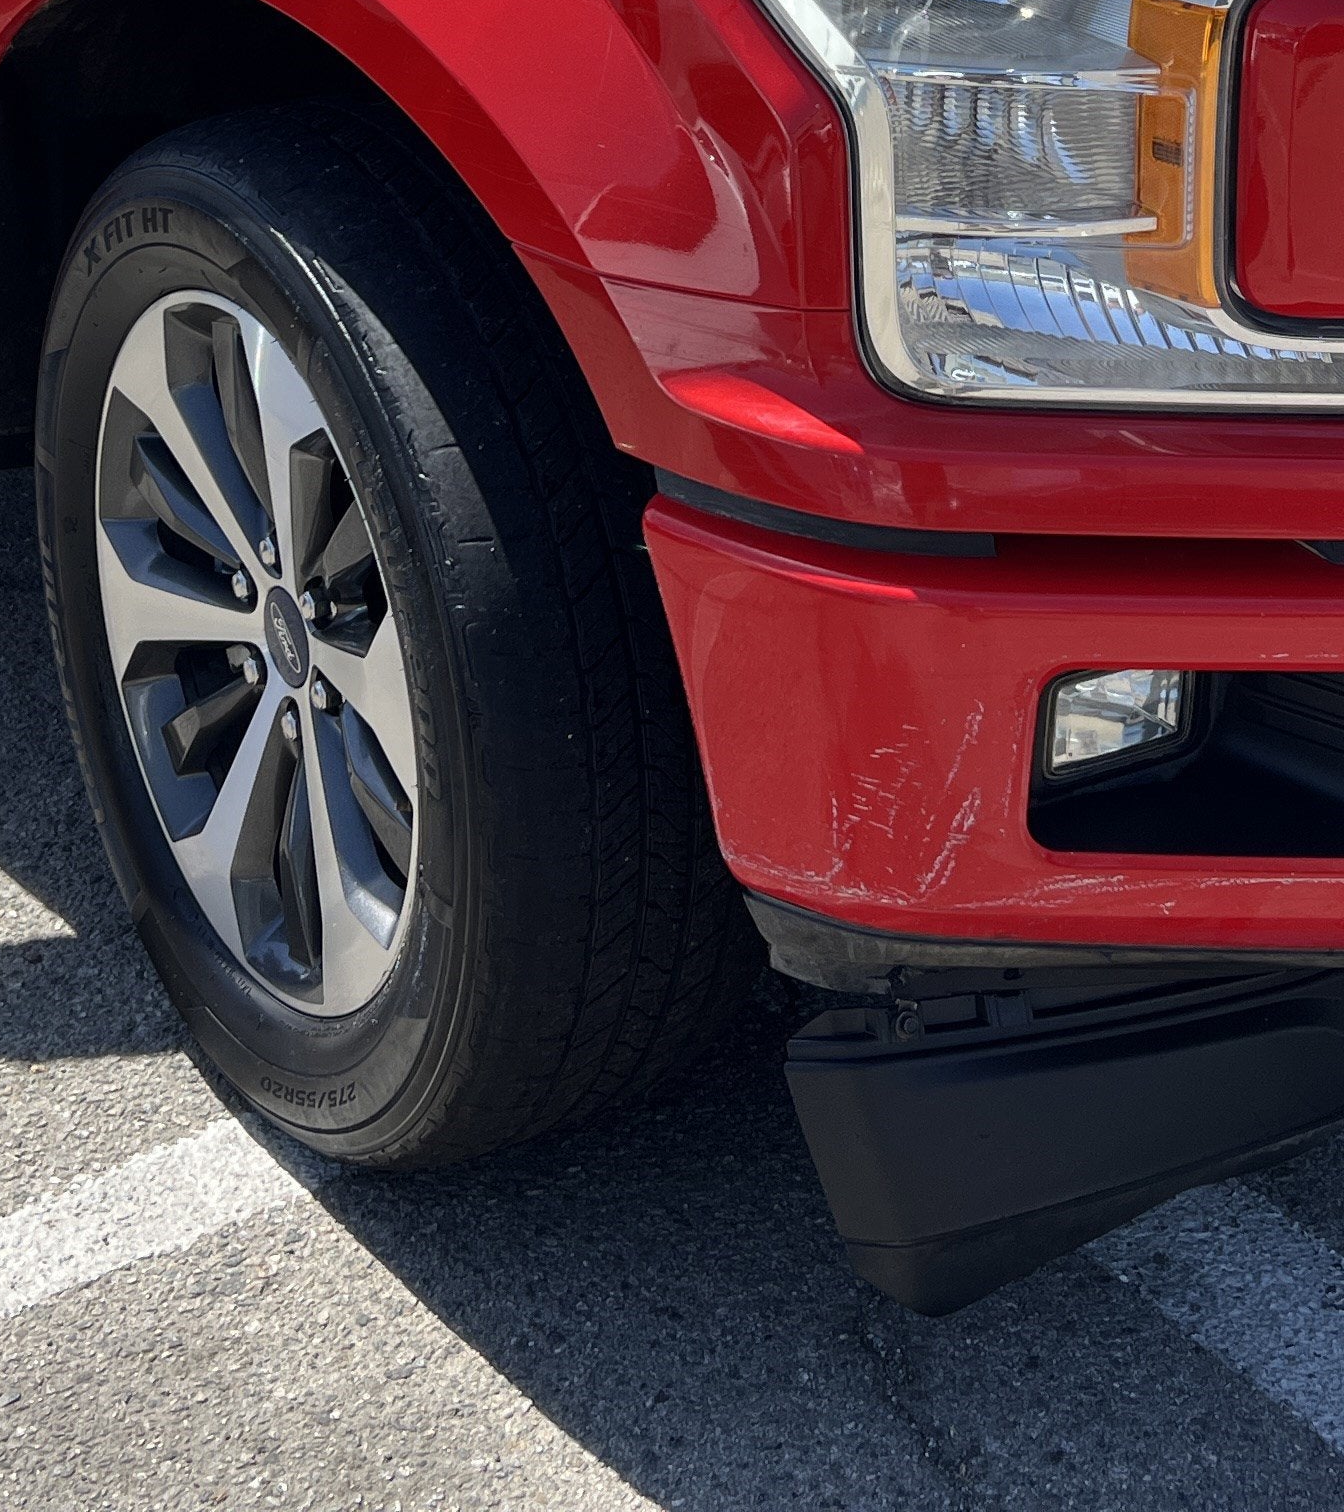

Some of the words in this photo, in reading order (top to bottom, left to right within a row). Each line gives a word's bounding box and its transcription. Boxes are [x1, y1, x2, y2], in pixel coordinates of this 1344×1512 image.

[104, 210, 134, 252] FIT
[142, 208, 173, 233] HT
[260, 1076, 356, 1109] 275/55R20
